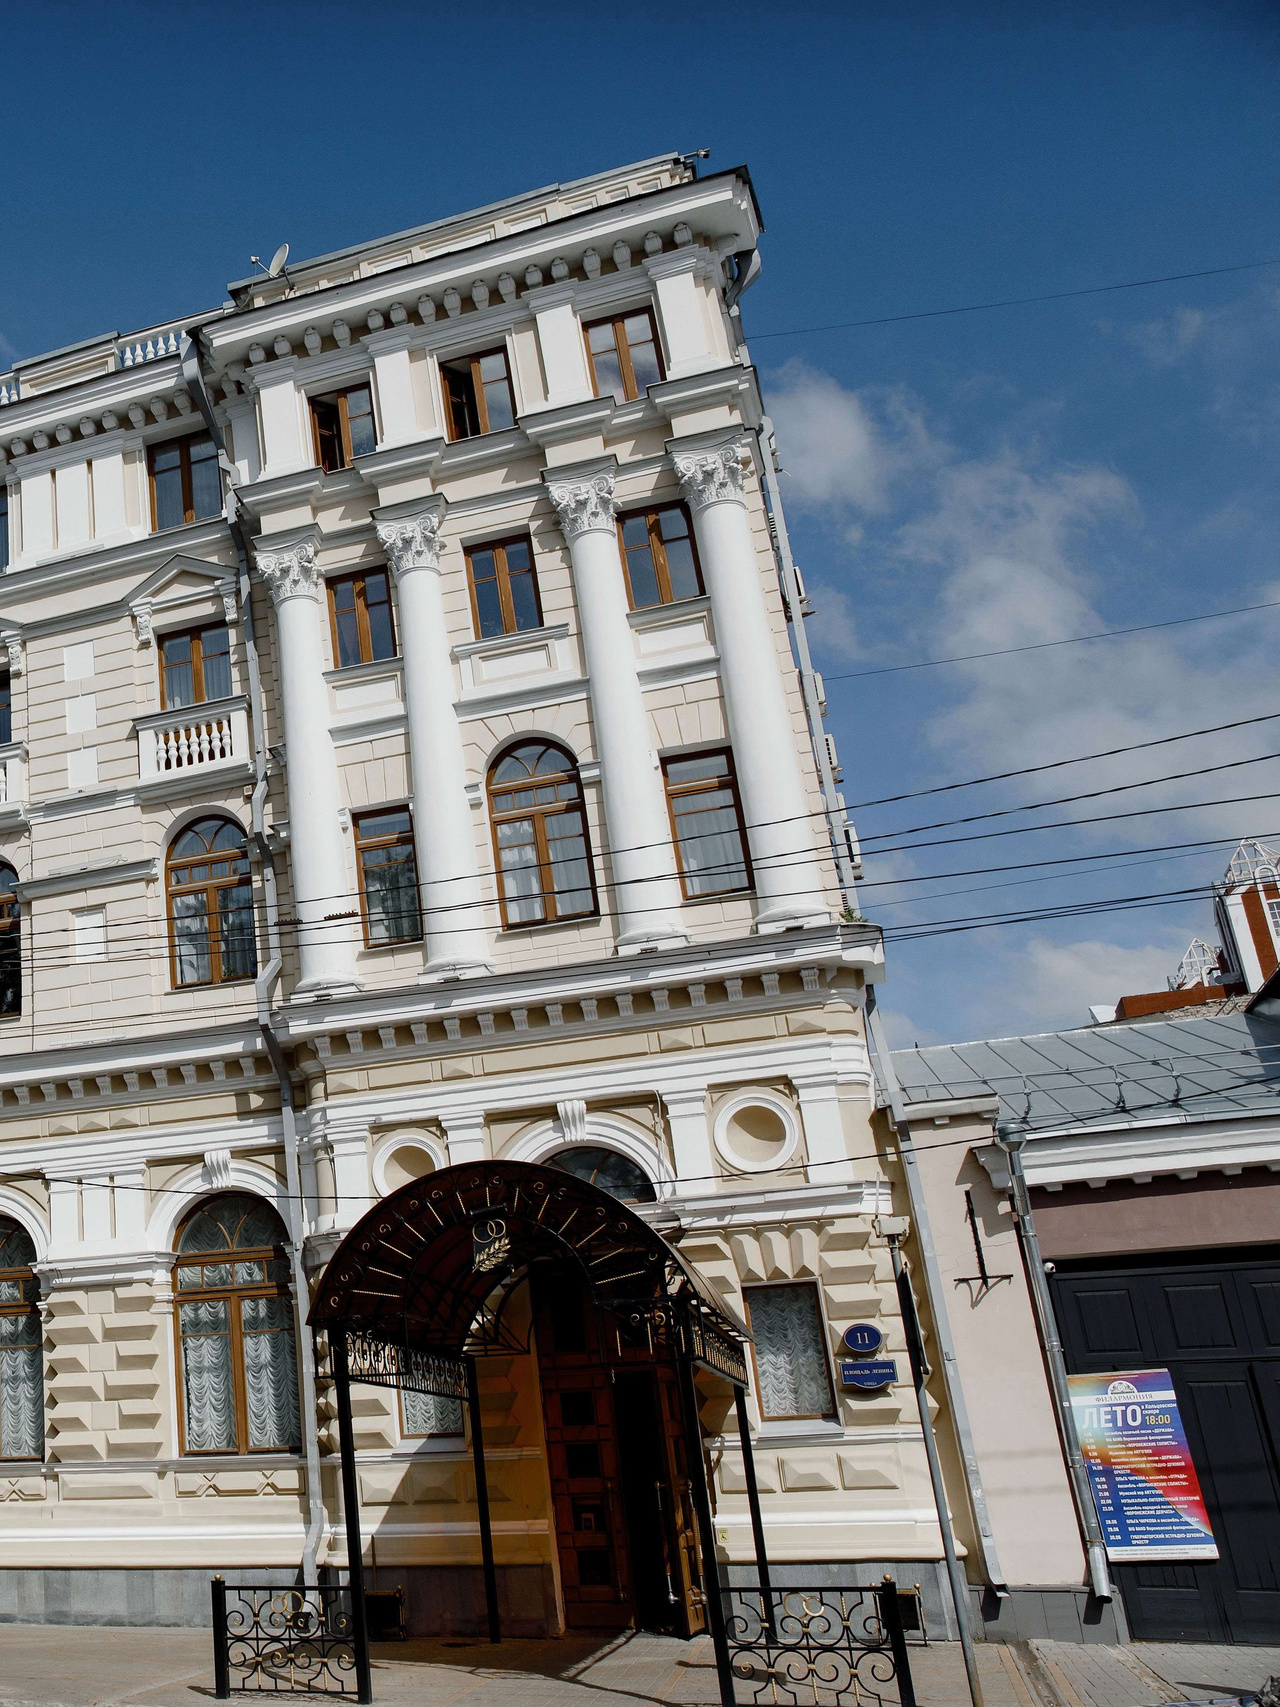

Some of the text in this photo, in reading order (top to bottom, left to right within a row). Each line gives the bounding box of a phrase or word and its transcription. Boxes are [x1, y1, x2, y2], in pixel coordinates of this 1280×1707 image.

[856, 1332, 870, 1344] 11
[1095, 1394, 1153, 1402] ФИЛАРМОНИЯ
[1082, 1405, 1142, 1429] ЛЕТО
[1145, 1415, 1170, 1425] 18:00
